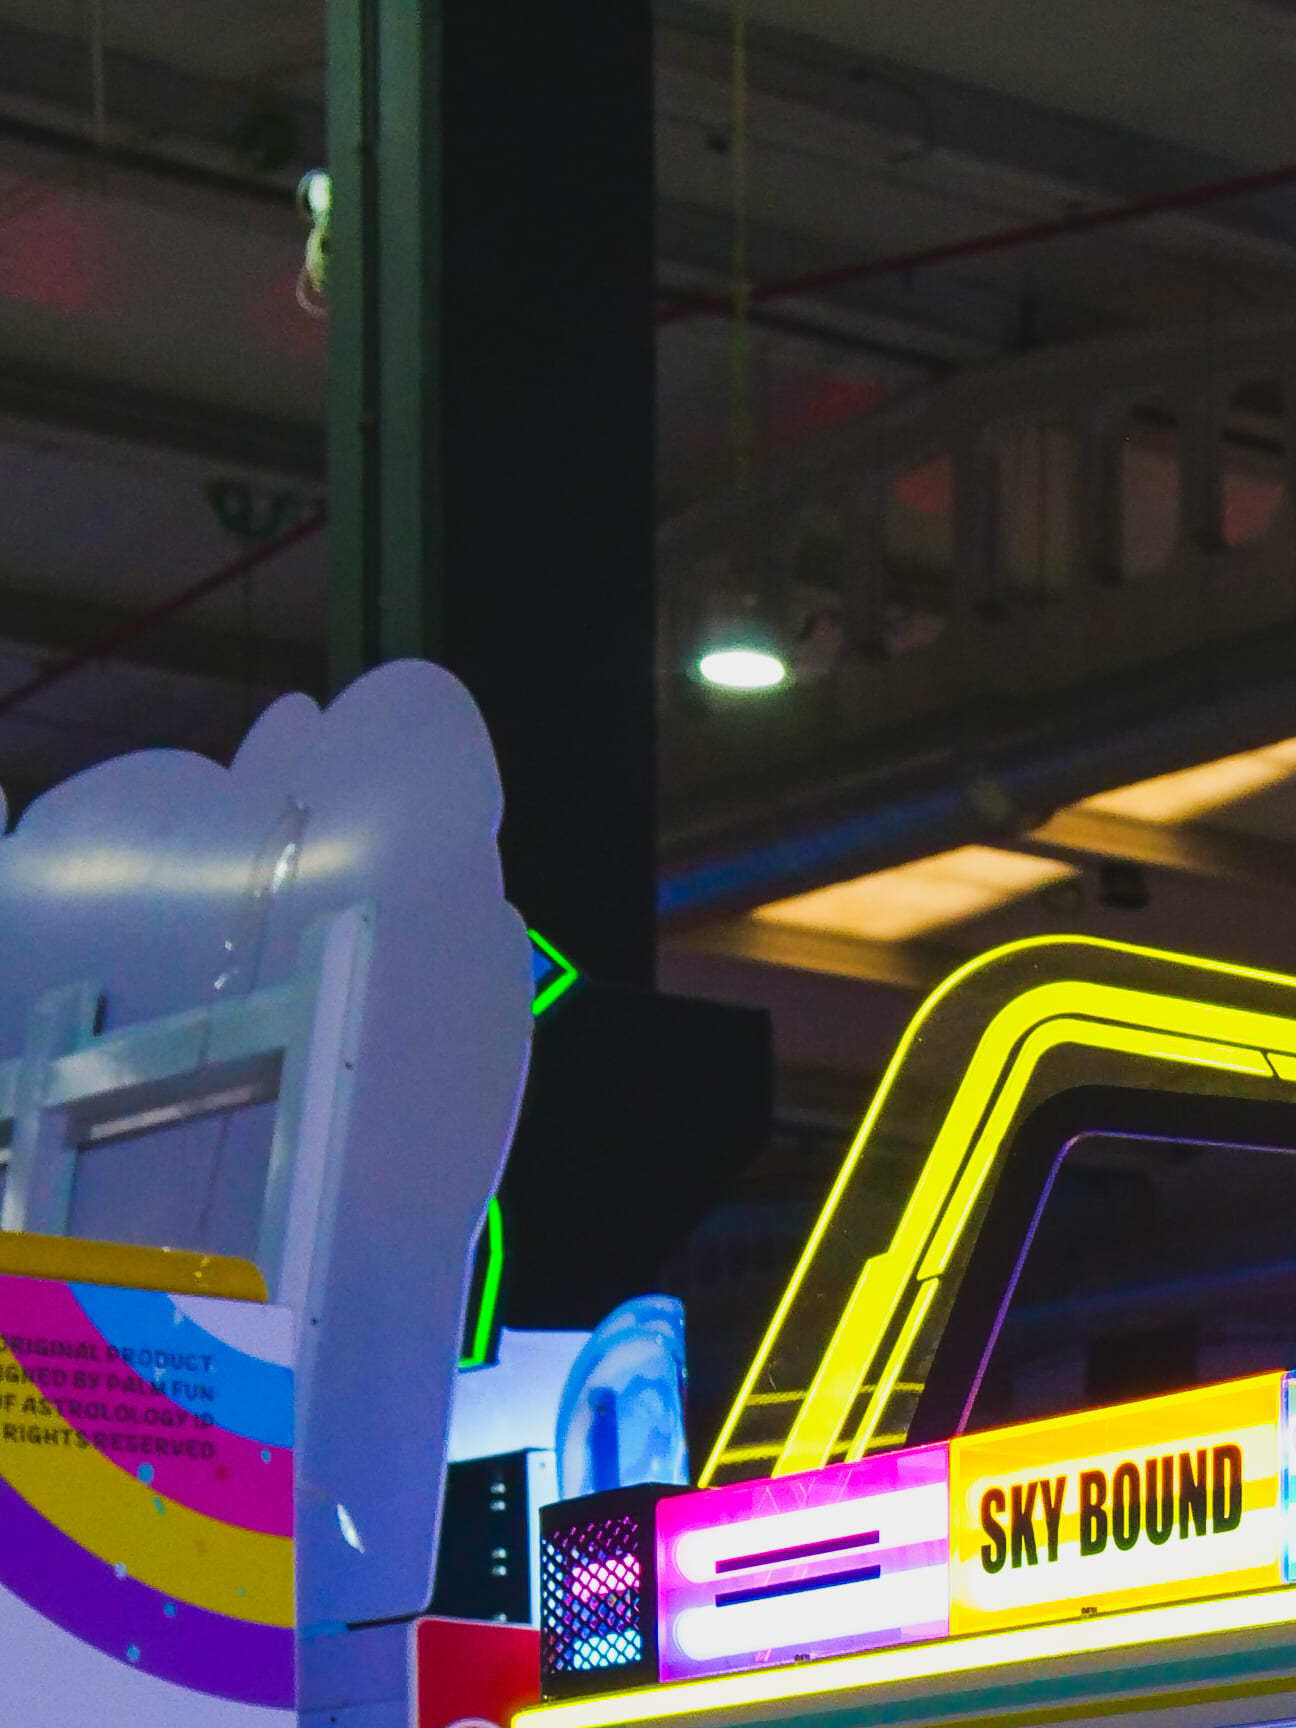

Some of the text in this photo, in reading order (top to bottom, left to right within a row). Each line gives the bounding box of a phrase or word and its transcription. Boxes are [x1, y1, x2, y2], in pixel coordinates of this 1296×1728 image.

[106, 1346, 213, 1373] PRODUCT
[173, 1382, 214, 1402] FUN
[3, 1423, 215, 1460] RIGHTS RESERVED
[980, 1443, 1243, 1575] SKY BOUND
